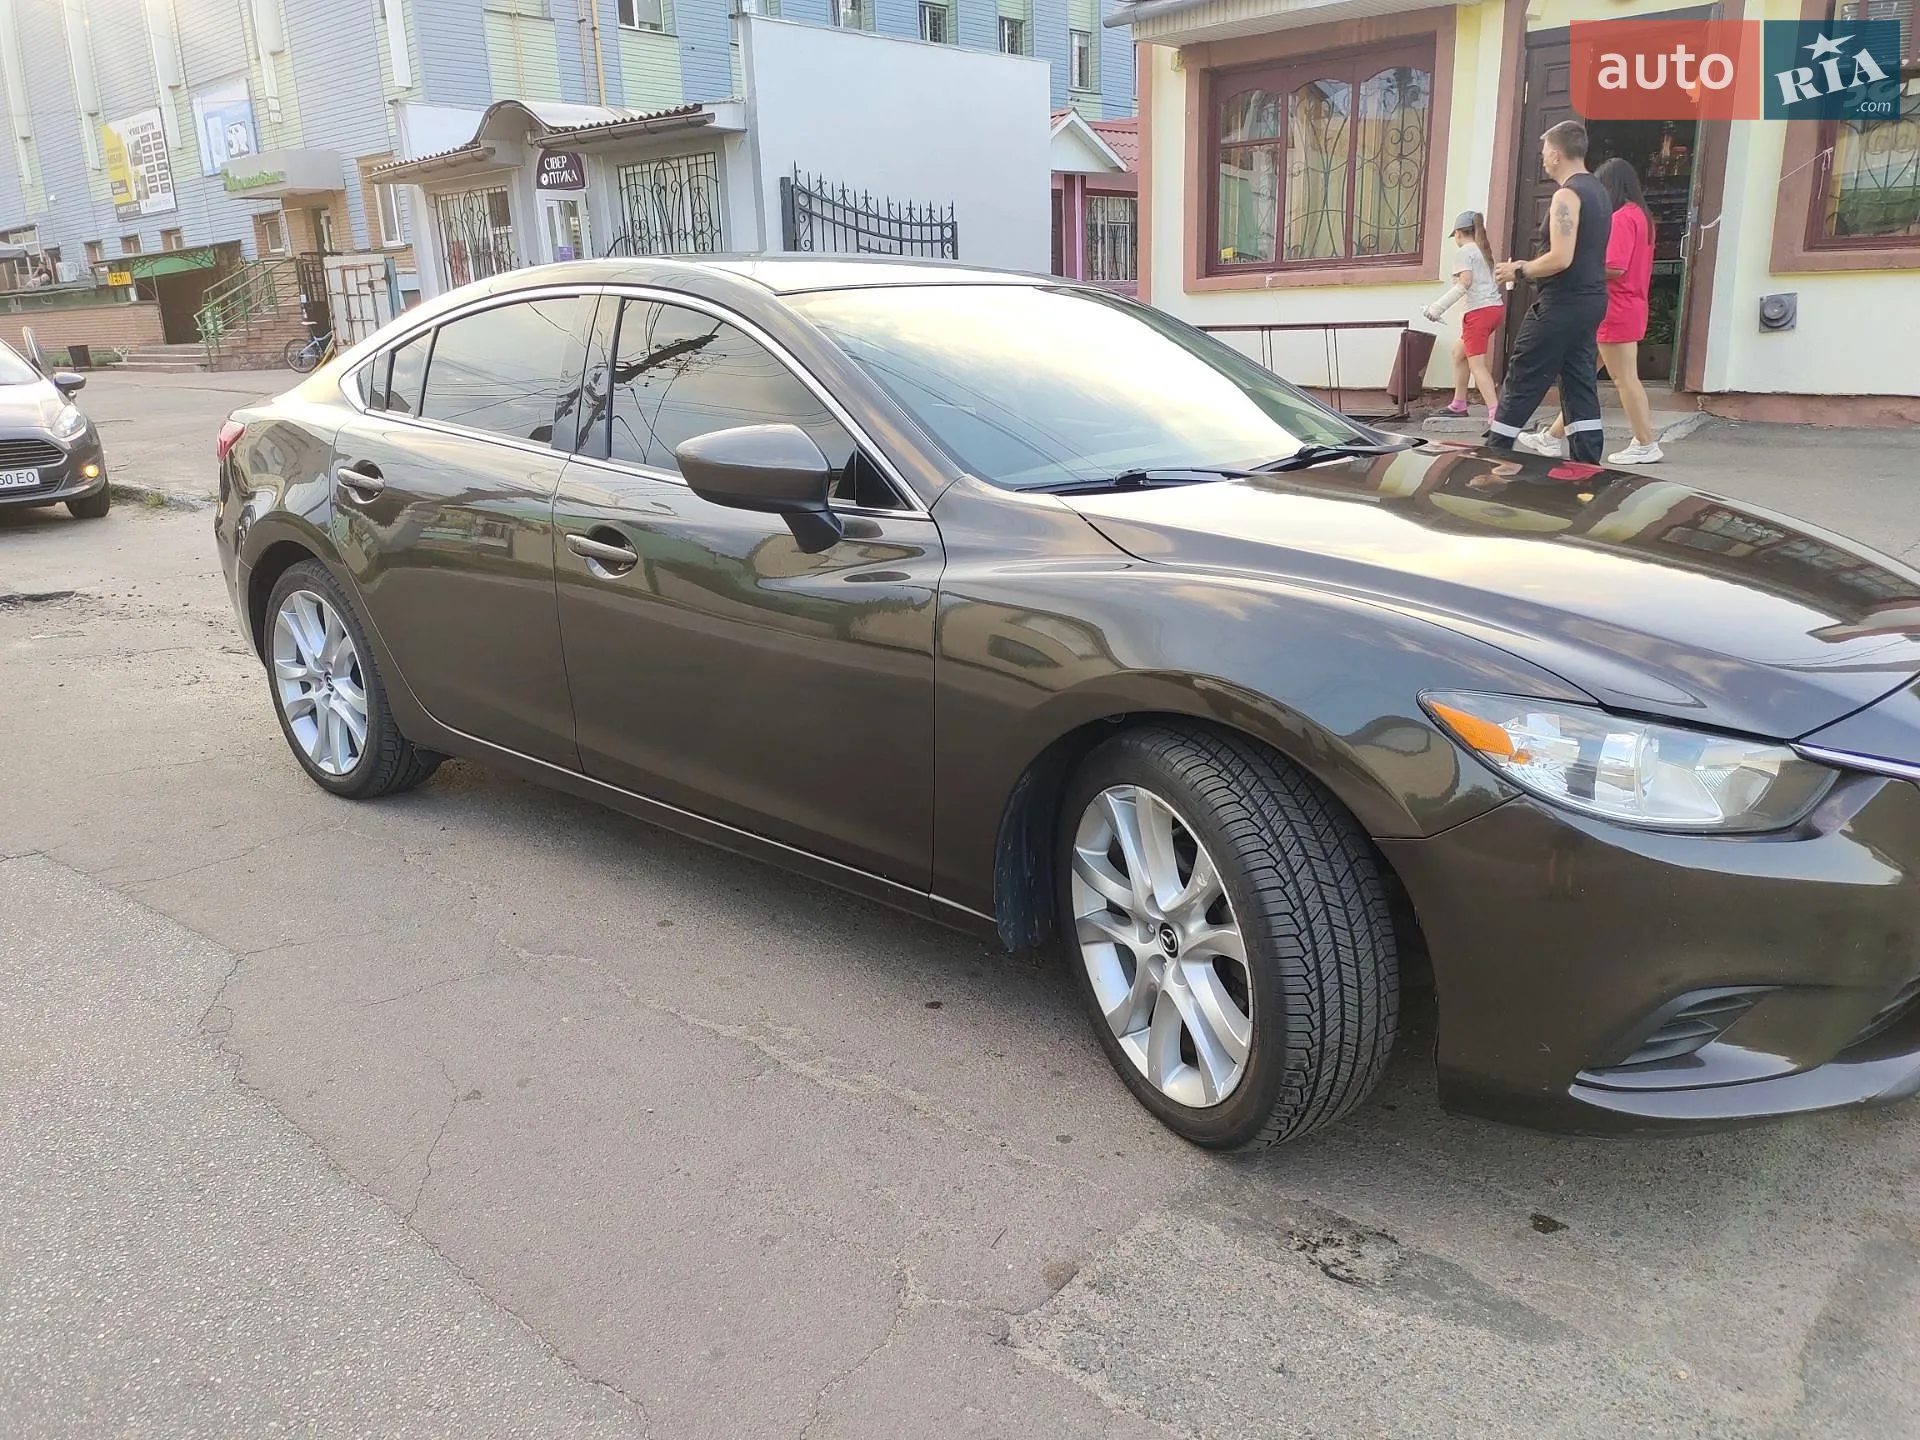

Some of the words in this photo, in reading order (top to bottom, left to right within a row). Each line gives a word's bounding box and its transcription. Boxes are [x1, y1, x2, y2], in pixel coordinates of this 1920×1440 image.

[544, 155, 567, 171] СІВЕР
[541, 169, 578, 186] ОПТИКА
[16, 471, 35, 484] EO
